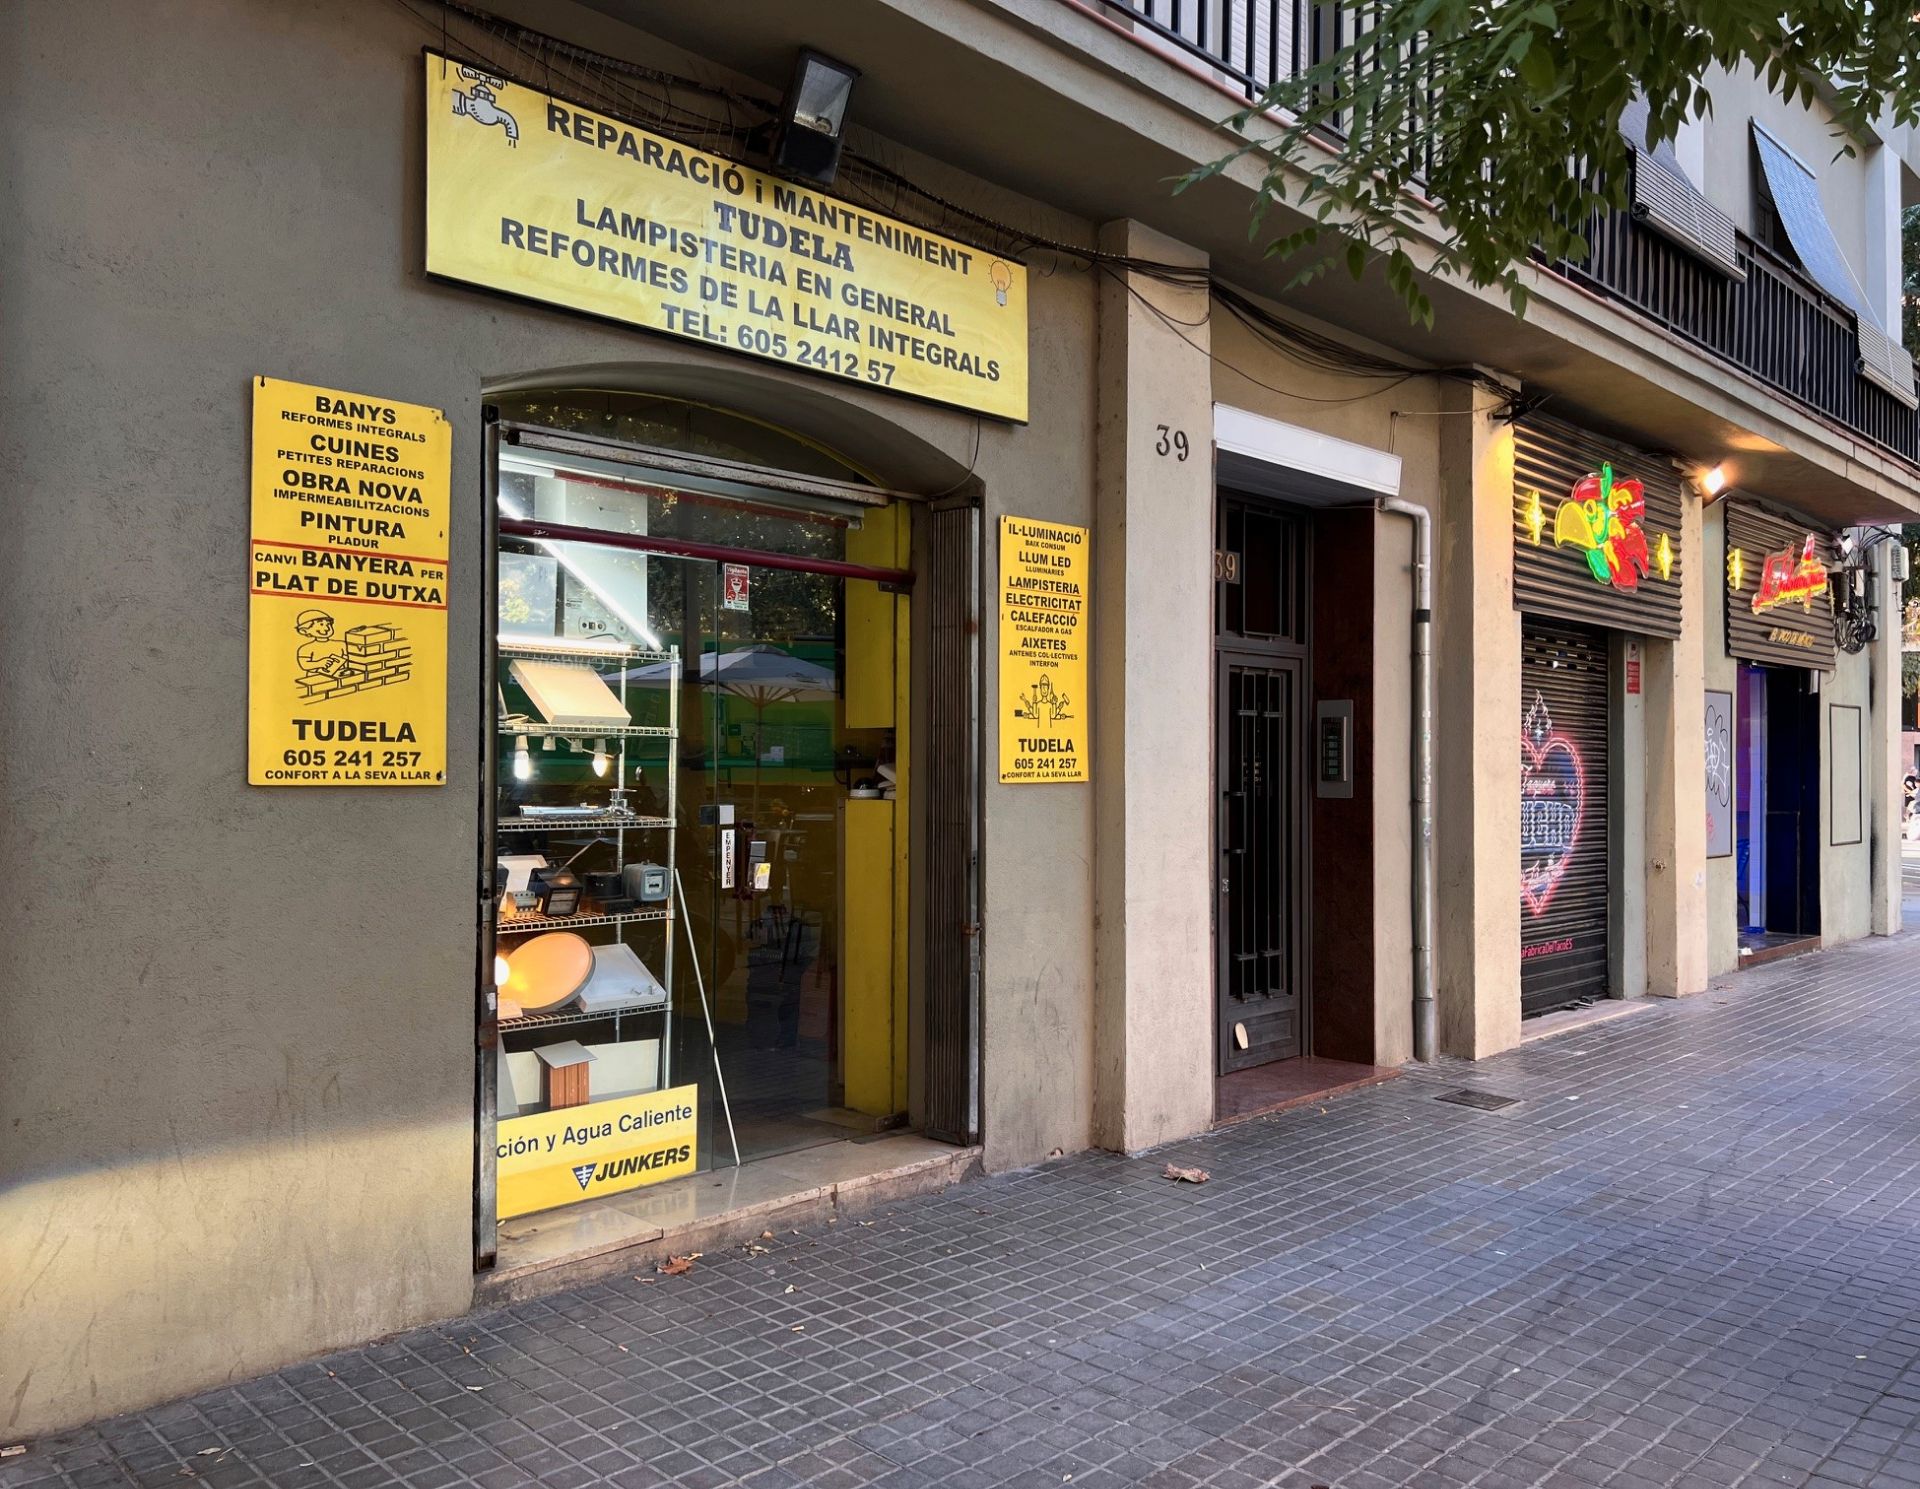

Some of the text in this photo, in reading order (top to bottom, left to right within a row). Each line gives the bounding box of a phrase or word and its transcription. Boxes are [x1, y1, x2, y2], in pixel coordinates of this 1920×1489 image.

[547, 102, 972, 275] REPARACIÓ i MANTENIMENT
[714, 200, 854, 272] TUDELA
[577, 199, 955, 337] LAMPISTERIA EN GENERAL
[501, 217, 1000, 382] REFORMES DE LA LLAR INTEGRALS
[661, 303, 896, 386] TEL: 605 2412 57
[316, 396, 396, 424] BANYS
[282, 411, 426, 442] REFORMES INTEGRALS
[311, 434, 400, 462] CUINES
[1156, 424, 1190, 462] 39
[278, 450, 424, 480] PETITES REPARACIONS
[283, 470, 422, 503] OBRA NOVA
[274, 489, 430, 517] IMPERMEABILITZACIONS
[301, 511, 406, 538] PINTURA
[328, 535, 379, 548] PLADUR
[1026, 540, 1066, 551] BAIX CONSUM
[255, 550, 444, 580] CANVI BANYERA PER
[1019, 552, 1071, 568] LLUM LED
[1215, 552, 1236, 580] 39
[256, 572, 442, 603] PLAT DE DUTXA
[1009, 576, 1079, 594] LAMPISTERIA
[1006, 592, 1082, 610] ELECTRICITAT
[1010, 610, 1077, 626] CALEFACCIÓ
[1009, 650, 1036, 658] ANTENES
[1022, 637, 1066, 650] AIXETES
[1030, 660, 1058, 668] INTERFON
[292, 720, 416, 742] TUDELA
[283, 750, 422, 767] 605 241 257
[1018, 739, 1074, 752] TUDELA
[265, 770, 430, 780] CONFORT A LA SEVA LLAR
[1014, 758, 1076, 769] 605 241 257
[546, 1134, 556, 1152] y
[562, 1123, 612, 1146] Agua
[618, 1105, 692, 1132] Caliente
[596, 1145, 690, 1182] JUNKERS
